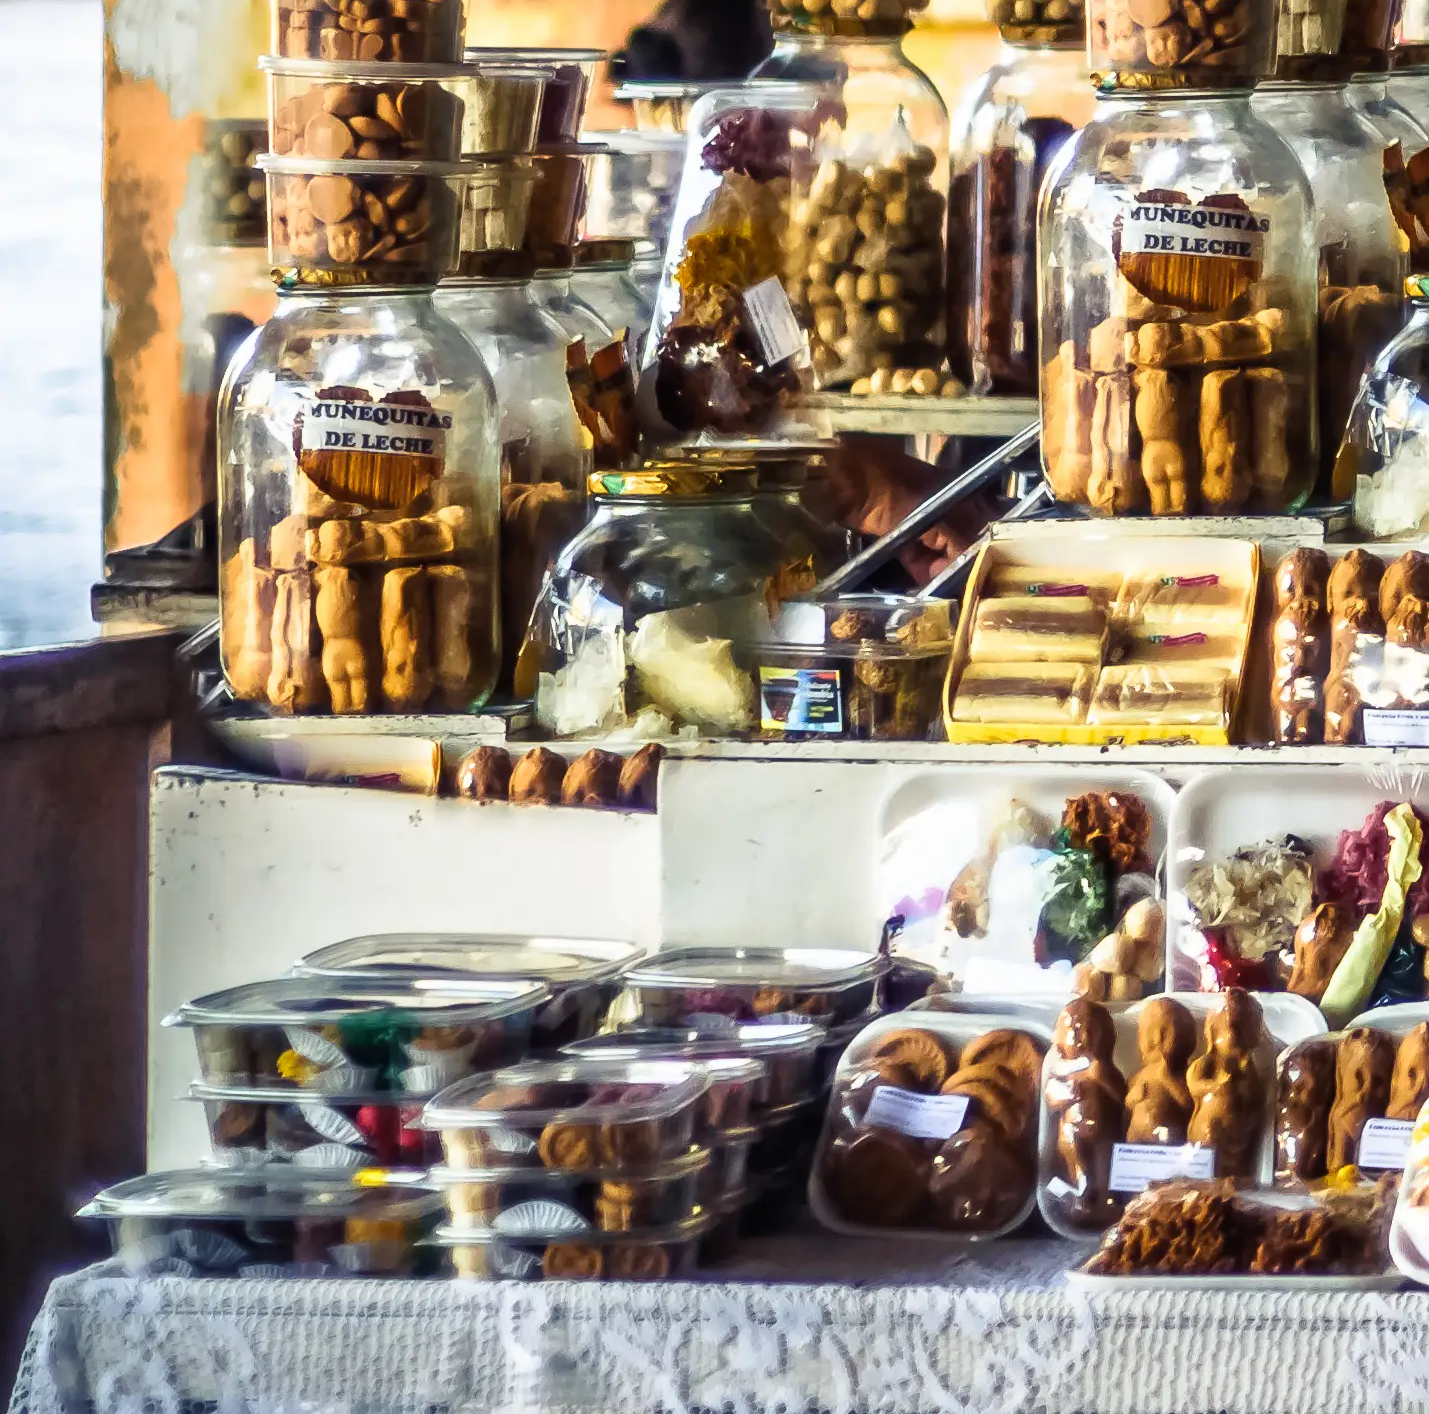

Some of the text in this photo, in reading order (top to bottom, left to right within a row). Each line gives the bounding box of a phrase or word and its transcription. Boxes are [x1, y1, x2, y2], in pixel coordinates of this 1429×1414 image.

[1144, 234, 1252, 257] DE LECHE
[325, 431, 434, 455] DE LECHE
